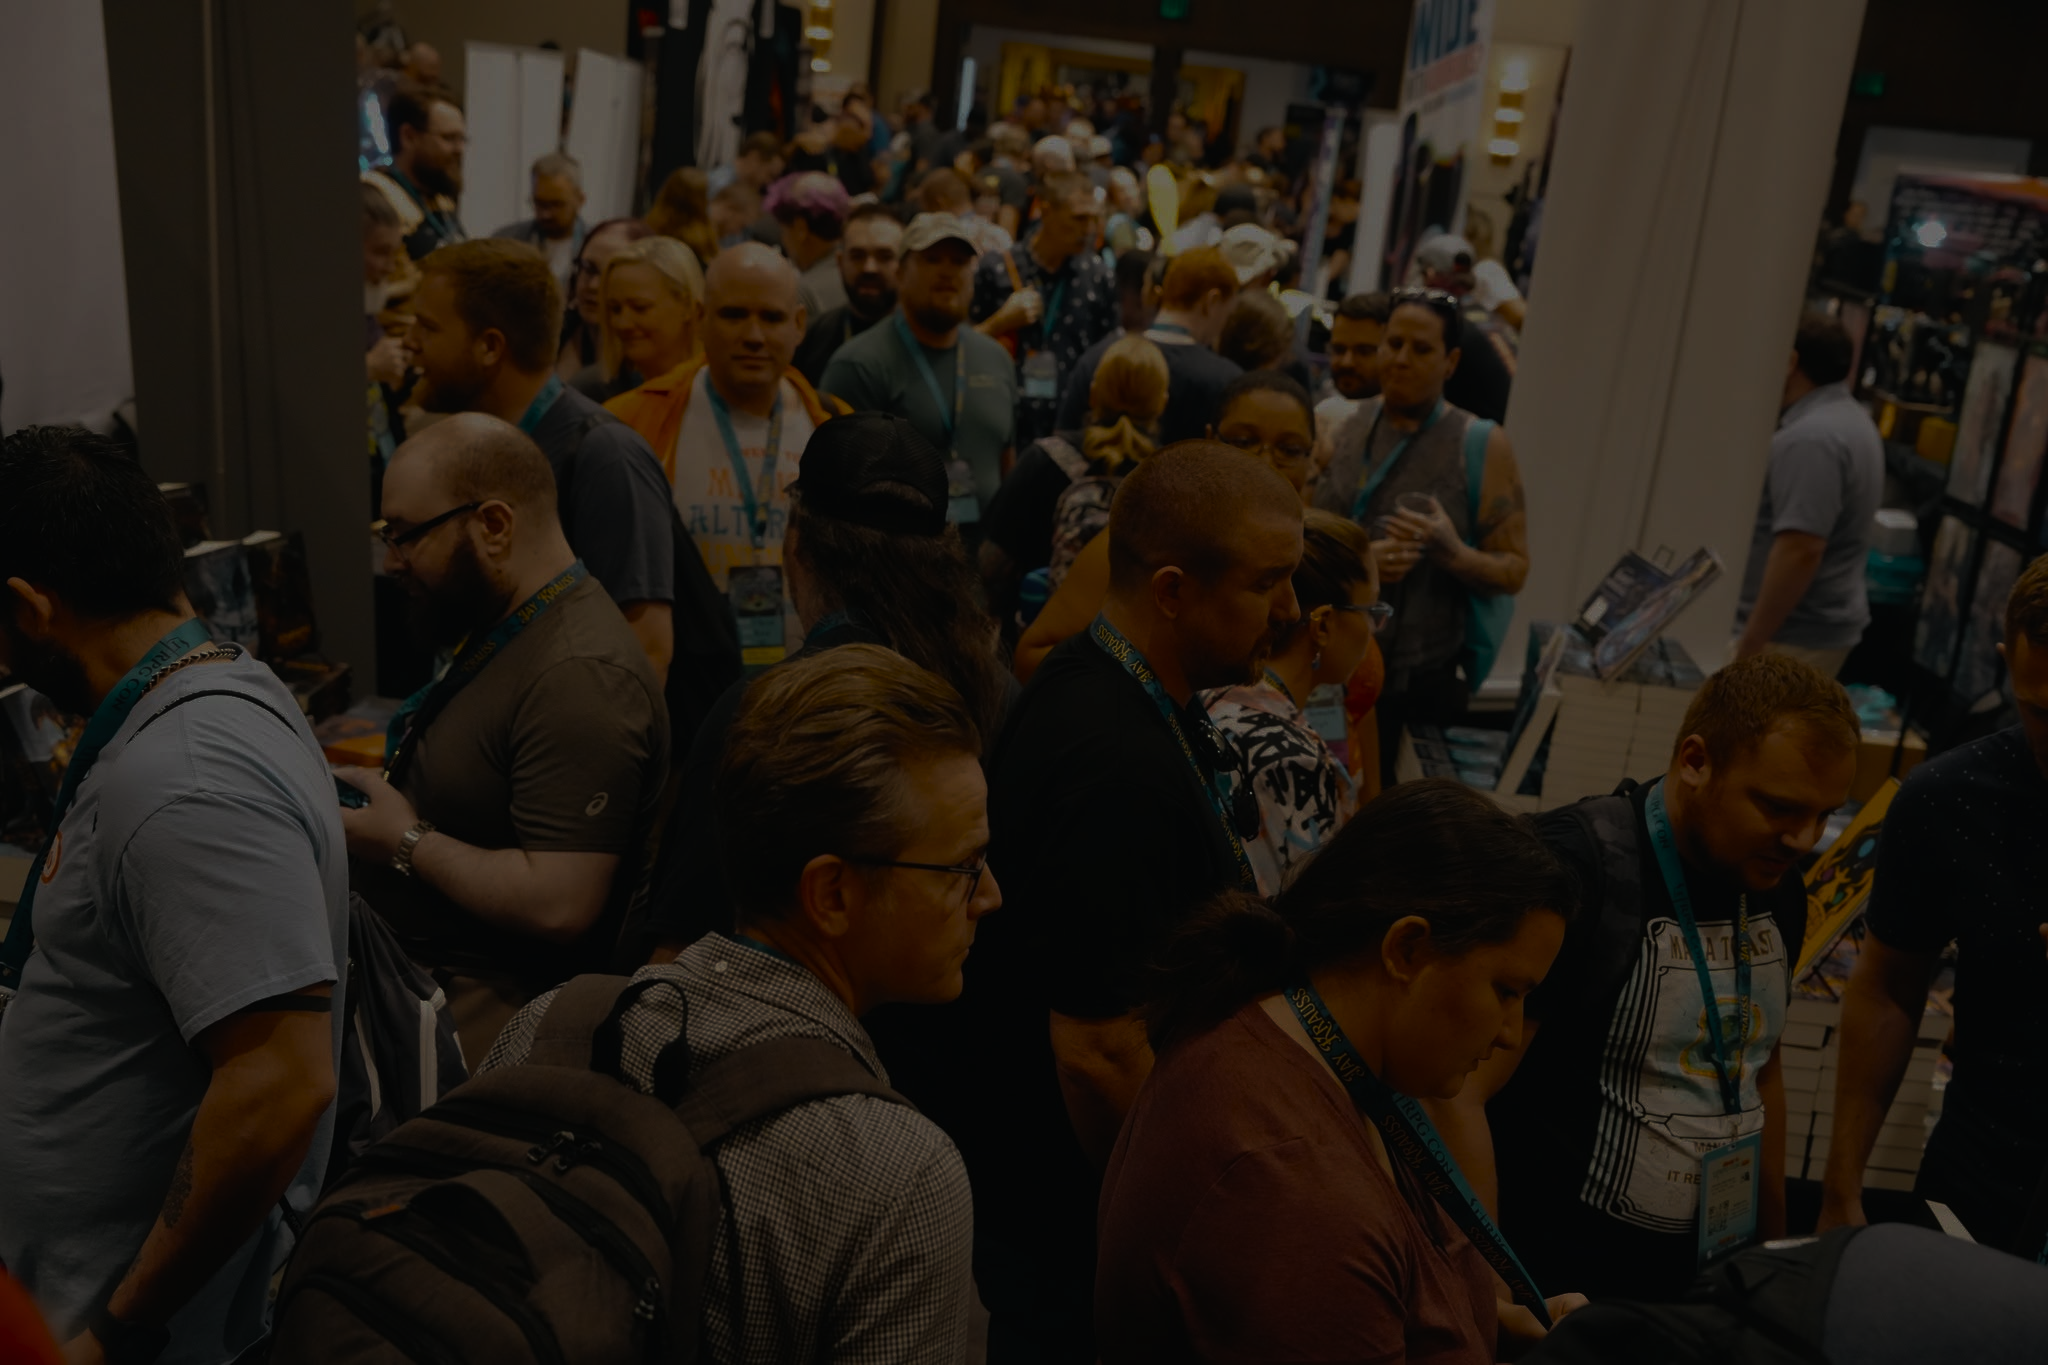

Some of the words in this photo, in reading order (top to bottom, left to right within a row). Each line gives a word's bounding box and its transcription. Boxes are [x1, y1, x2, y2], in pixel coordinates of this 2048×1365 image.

[1096, 624, 1135, 663] KRAUSS
[1129, 659, 1154, 684] JAY
[112, 678, 140, 711] CON
[1669, 934, 1716, 961] MAA
[1291, 987, 1342, 1053] KRAUSS
[1331, 1052, 1366, 1083] JAY
[1380, 1114, 1428, 1170] KRAUSS
[1427, 1137, 1453, 1175] CON
[1423, 1170, 1454, 1197] JAY
[1667, 1170, 1680, 1182] IT
